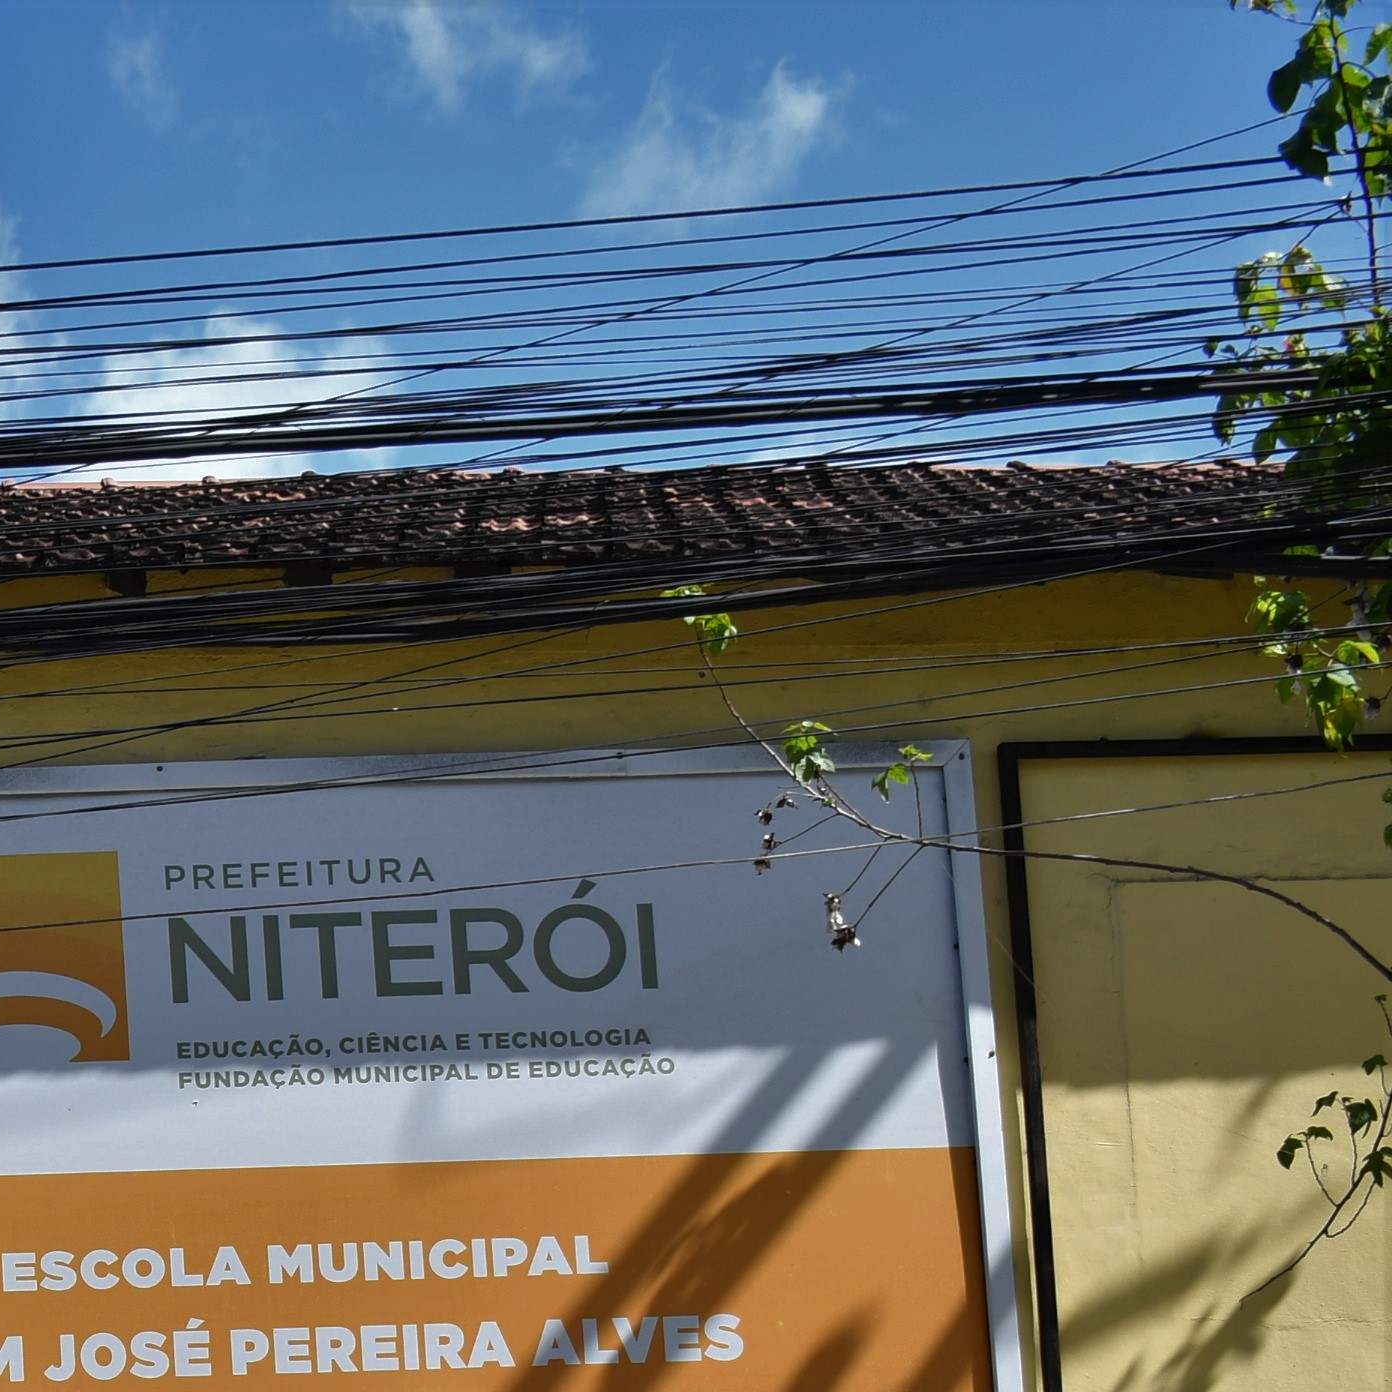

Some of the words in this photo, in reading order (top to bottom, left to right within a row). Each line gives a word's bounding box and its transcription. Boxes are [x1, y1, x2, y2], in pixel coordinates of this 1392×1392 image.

[164, 856, 435, 891] PREFEITURA
[168, 878, 659, 1004] NITERÓI
[176, 1036, 331, 1060] EDUCAÇÃO,
[338, 1031, 448, 1054] CIÊNCIA
[455, 1033, 470, 1051] E
[481, 1028, 651, 1049] TECNOLOGIA
[178, 1064, 325, 1089] FUNDAÇÃO
[333, 1062, 478, 1085] MUNICIPAL
[486, 1062, 521, 1080] DE
[527, 1053, 675, 1079] EDUCAÇÃO
[1, 1245, 251, 1292] ESCOLA
[267, 1235, 609, 1285] MUNICIPAL
[44, 1317, 212, 1382] JOSÉ
[230, 1320, 516, 1375] PEREIRA
[531, 1313, 746, 1367] ALVES
